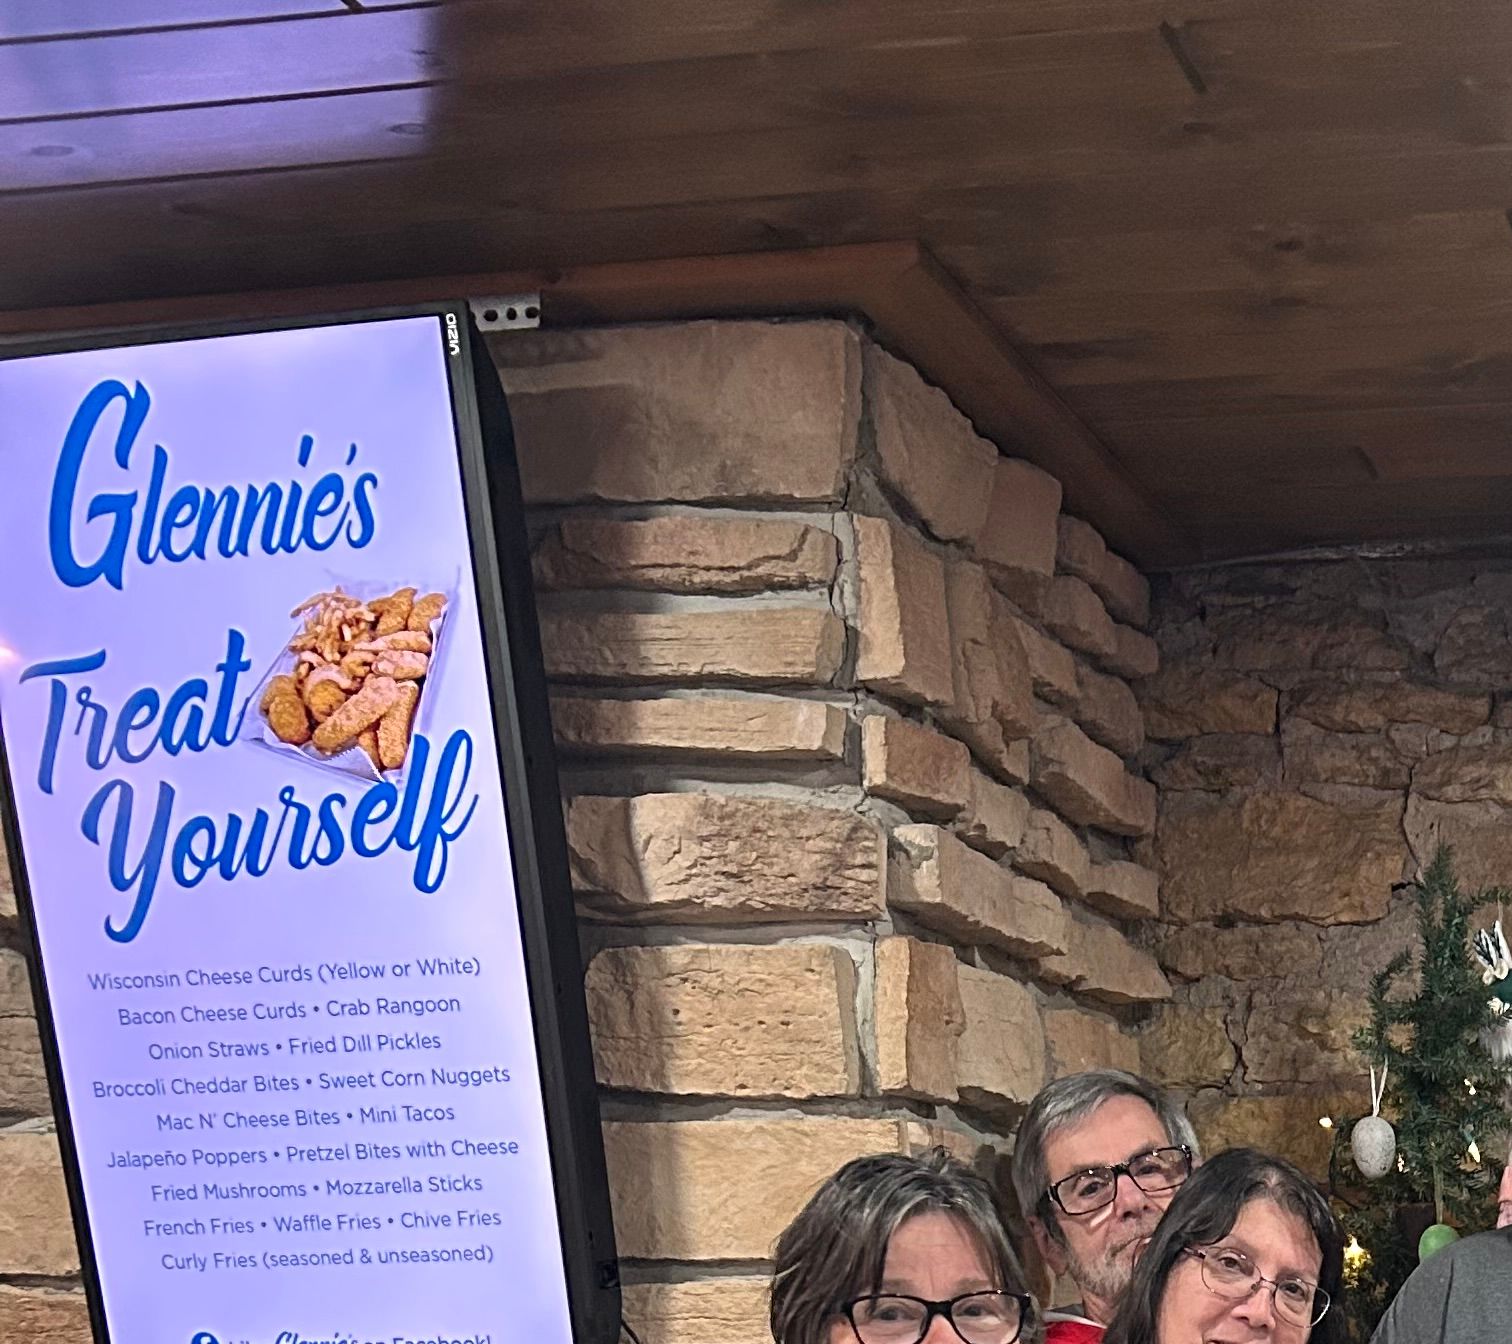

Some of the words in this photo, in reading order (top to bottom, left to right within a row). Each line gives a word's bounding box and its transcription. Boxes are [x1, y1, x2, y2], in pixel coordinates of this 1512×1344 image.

[445, 312, 460, 355] VIZIO
[48, 379, 378, 590] Glennie's
[19, 629, 251, 794] Treat
[81, 729, 479, 943] Yourself
[87, 971, 181, 990] Wisconsin
[185, 968, 252, 986] Cheese
[258, 965, 312, 983] Curds
[318, 961, 385, 983] (Yellow
[392, 964, 410, 977] or
[416, 957, 480, 976] White)
[118, 1008, 176, 1025] Bacon
[180, 1006, 248, 1023] Cheese
[253, 1002, 306, 1020] Curds
[327, 999, 370, 1016] Crab
[376, 998, 460, 1016] Rangoon
[149, 1043, 203, 1060] Onion
[208, 1041, 269, 1058] Straws
[289, 1036, 336, 1055] Fried
[343, 1034, 371, 1053] Dill
[377, 1032, 441, 1051] Pickles
[93, 1078, 166, 1098] Broccoli
[171, 1077, 248, 1095] Cheddar
[254, 1075, 299, 1092] Bites
[319, 1072, 376, 1089] Sweet
[381, 1070, 425, 1087] Corn
[432, 1066, 511, 1087] Nuggets
[157, 1114, 193, 1131] Mac
[223, 1112, 289, 1128] Cheese
[295, 1109, 340, 1126] Bites
[360, 1106, 397, 1124] Mini
[402, 1105, 455, 1122] Tacos
[107, 1150, 187, 1170] Jalapeño
[192, 1149, 267, 1168] Poppers
[287, 1143, 349, 1162] Pretzel
[355, 1143, 401, 1160] Bites
[406, 1140, 446, 1158] with
[452, 1138, 518, 1156] Cheese
[151, 1184, 198, 1201] Fried
[203, 1182, 306, 1200] Mushrooms
[326, 1176, 422, 1195] Mozzarella
[428, 1174, 483, 1192] Sticks
[144, 1219, 205, 1236] French
[210, 1218, 254, 1234] Fries
[273, 1214, 331, 1232] Waffle
[337, 1213, 381, 1230] Fries
[401, 1211, 451, 1228] Chive
[457, 1209, 501, 1227] Fries
[161, 1253, 207, 1272] Curly
[214, 1251, 257, 1268] Fries
[263, 1249, 353, 1270] (seasoned
[360, 1248, 372, 1264] &
[378, 1244, 493, 1264] unseasoned)
